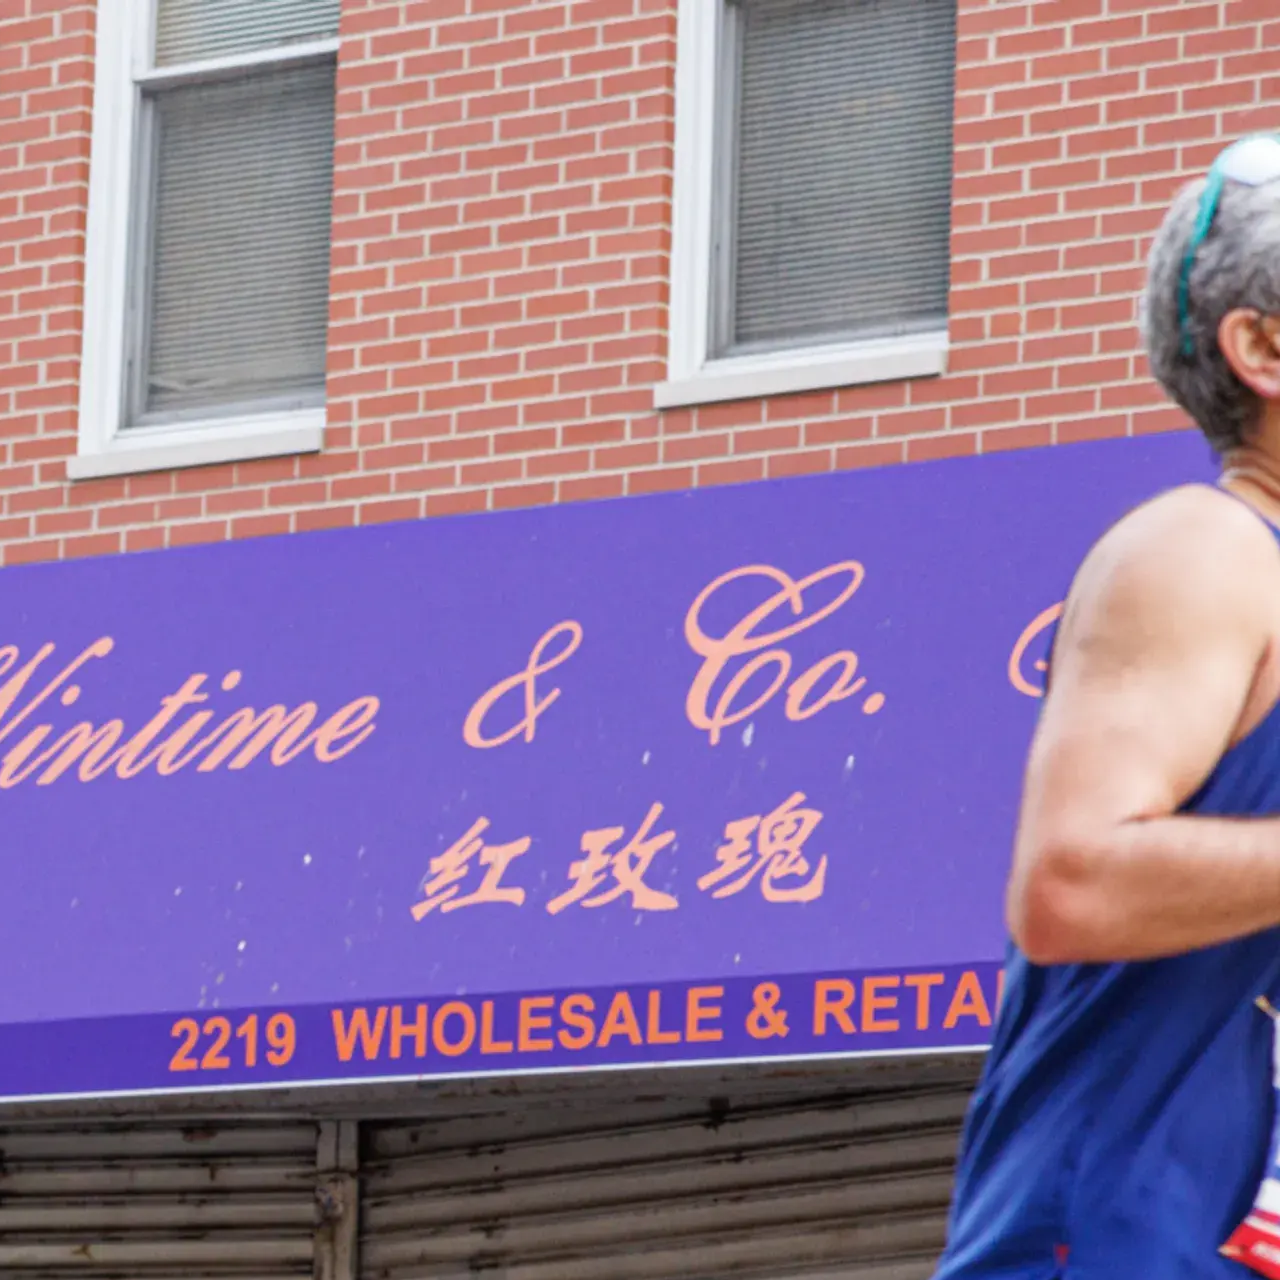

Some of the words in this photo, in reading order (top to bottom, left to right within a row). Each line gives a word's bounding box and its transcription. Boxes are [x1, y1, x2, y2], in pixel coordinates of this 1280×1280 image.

[463, 620, 583, 749] &
[684, 560, 886, 745] Co.
[168, 1012, 297, 1072] 2219
[331, 985, 725, 1062] WHOLESALE
[745, 981, 790, 1040] &
